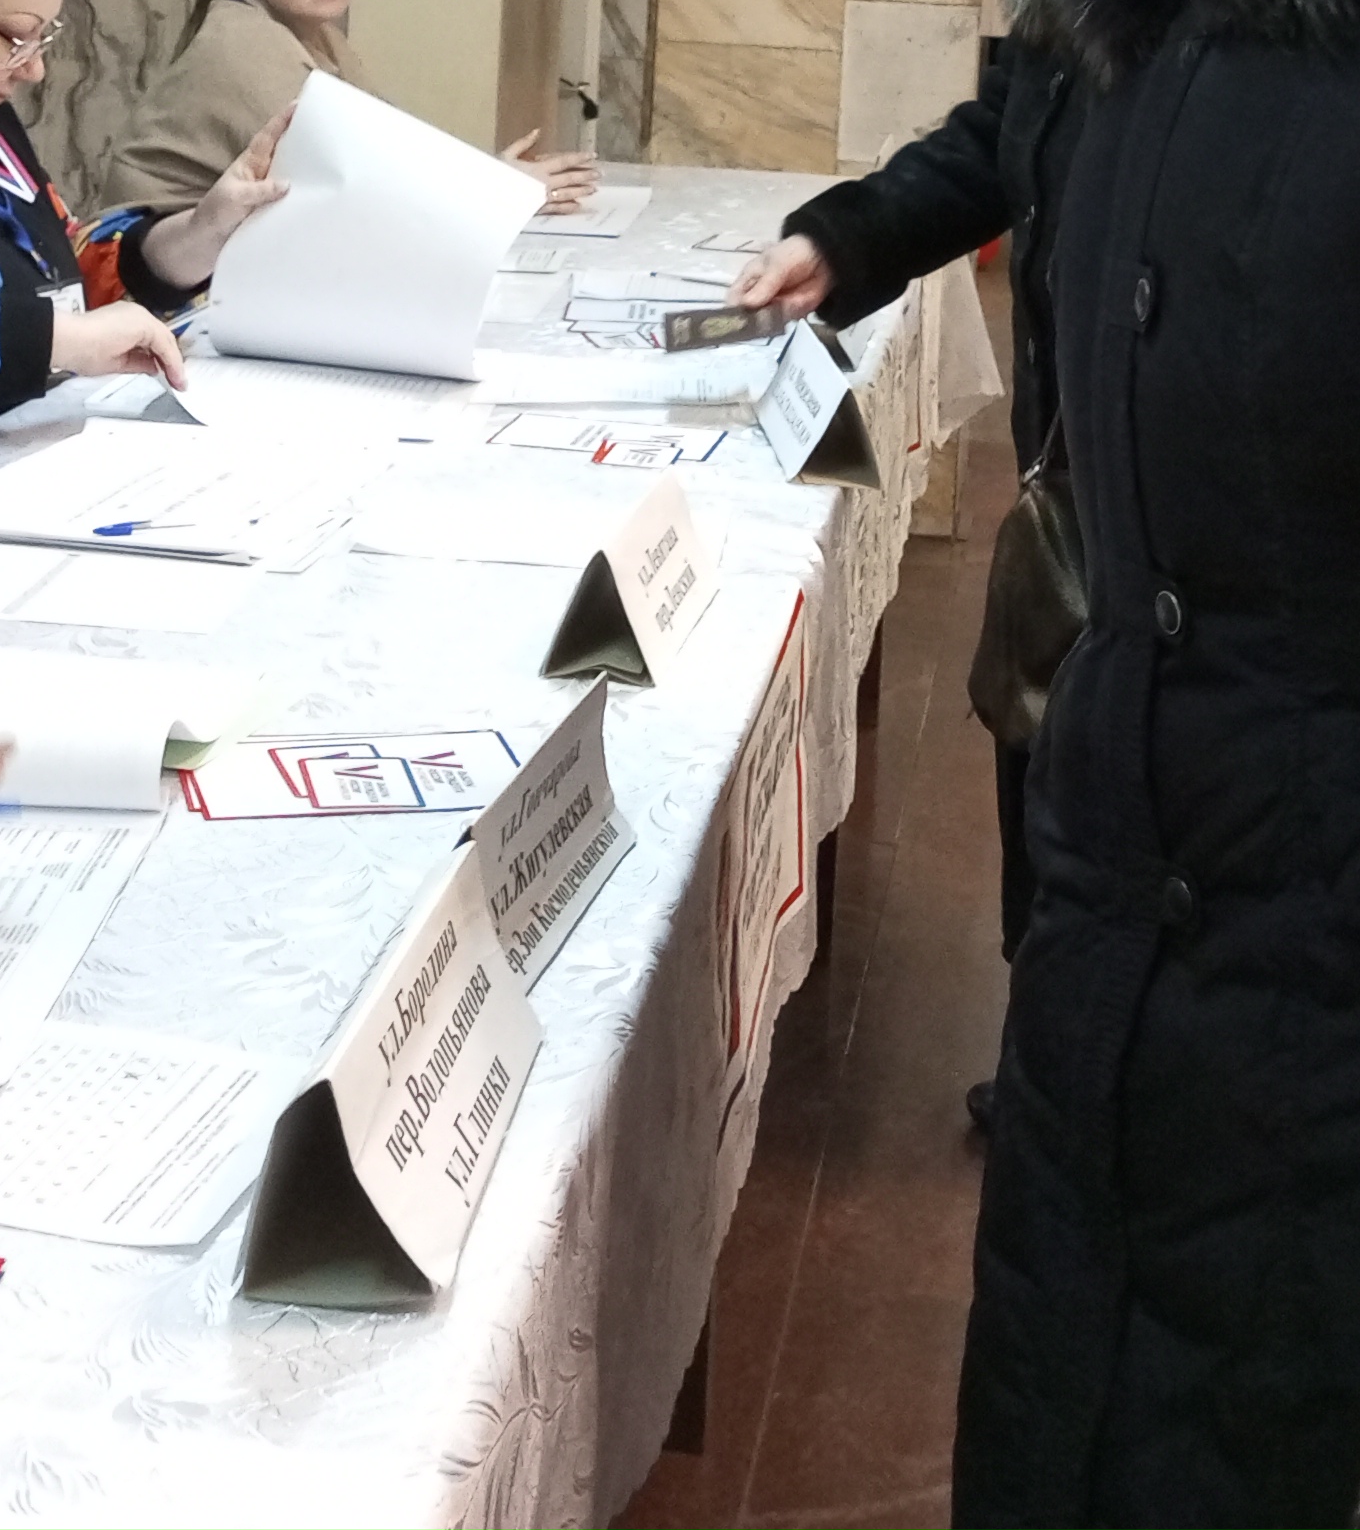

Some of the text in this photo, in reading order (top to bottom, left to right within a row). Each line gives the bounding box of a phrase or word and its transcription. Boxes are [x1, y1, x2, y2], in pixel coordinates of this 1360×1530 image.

[490, 783, 594, 936] ул.Жигулевская
[505, 815, 620, 976] ер.Зои Космодемьянской
[377, 919, 458, 1088] ул.Бородина
[384, 963, 492, 1174] пер.Водопьянова
[444, 1054, 511, 1208] ул.Глинки
